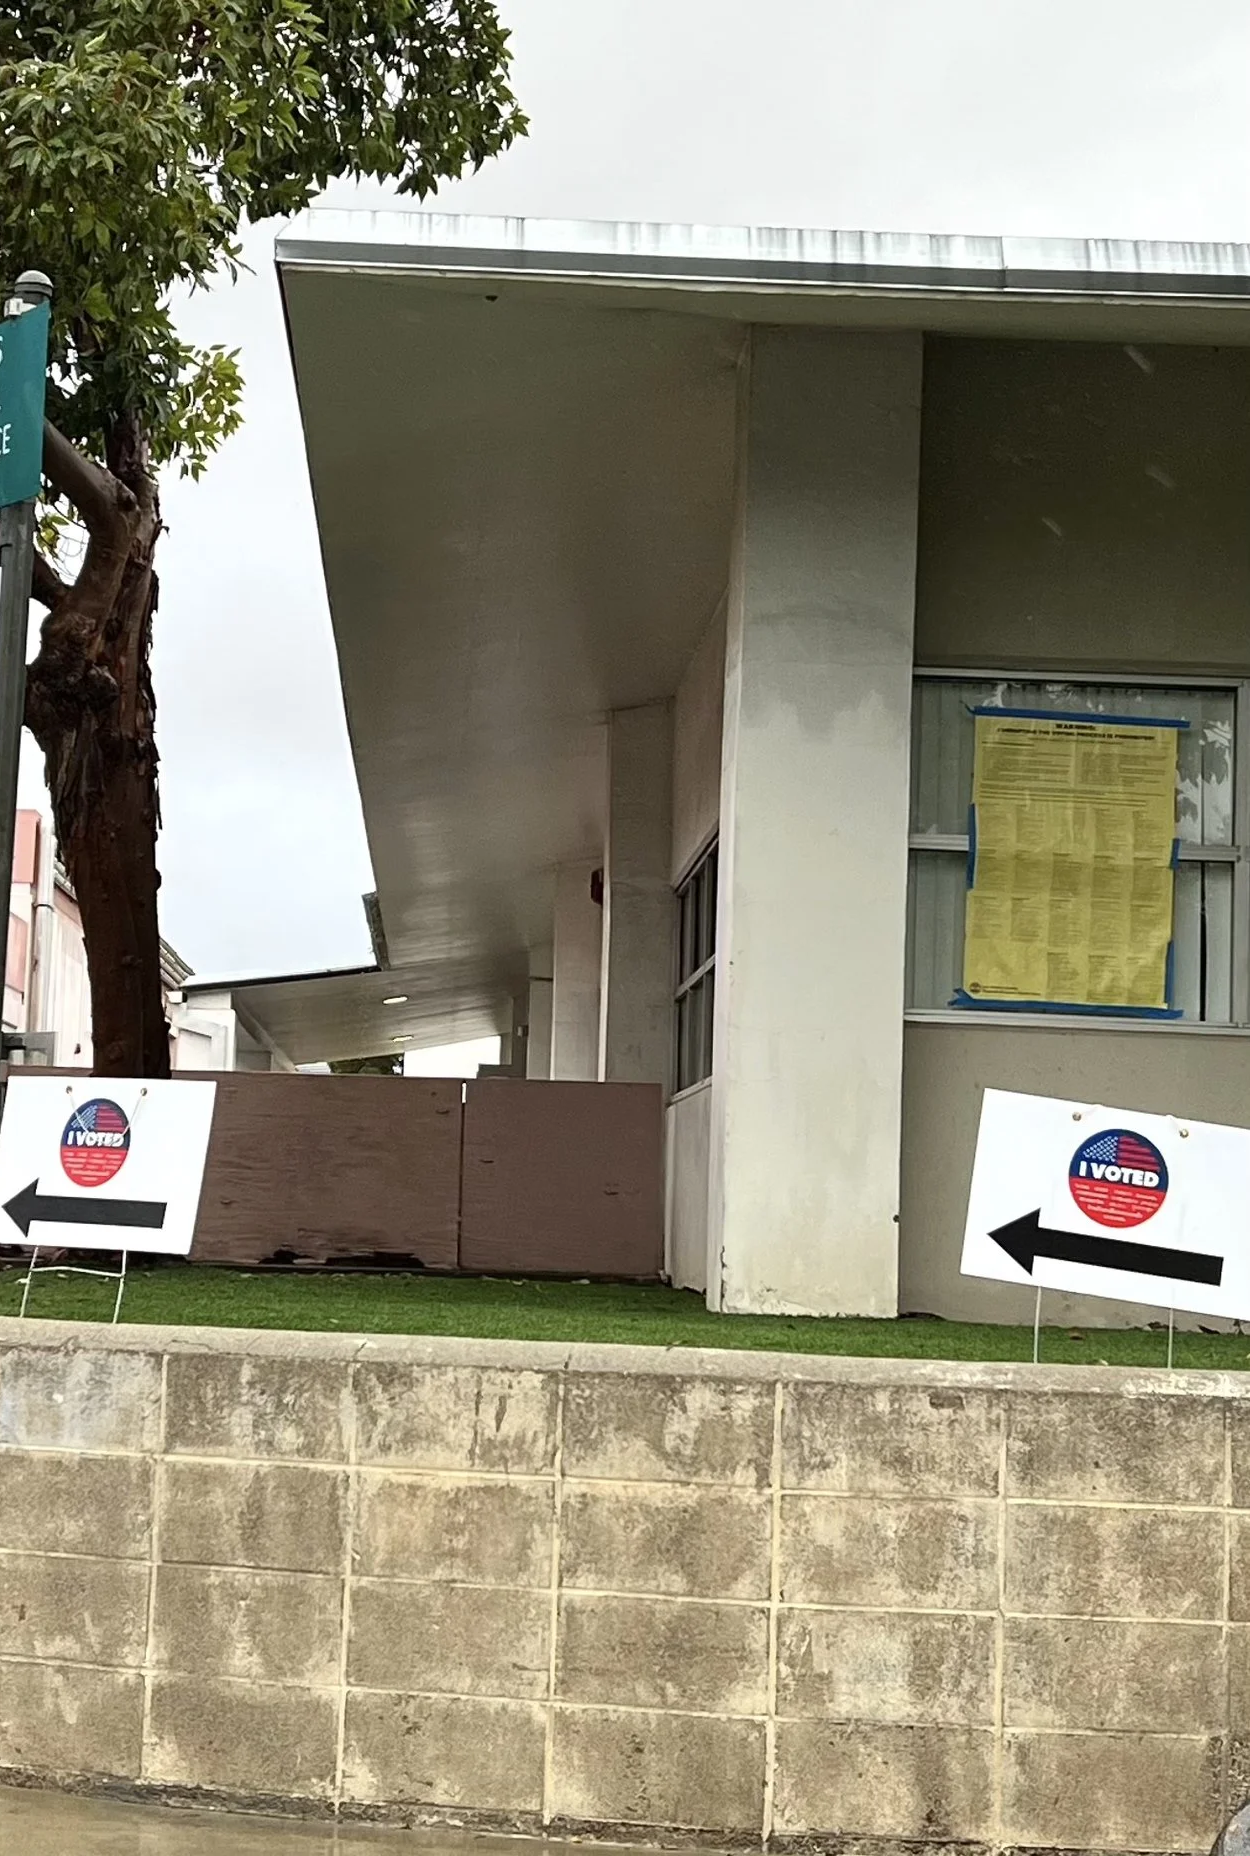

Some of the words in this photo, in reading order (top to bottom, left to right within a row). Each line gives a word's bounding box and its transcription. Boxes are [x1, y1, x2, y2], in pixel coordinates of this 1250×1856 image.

[67, 1130, 74, 1145] I
[76, 1131, 124, 1147] VOTED
[1078, 1161, 1087, 1177] I
[1090, 1162, 1159, 1187] VOTED
